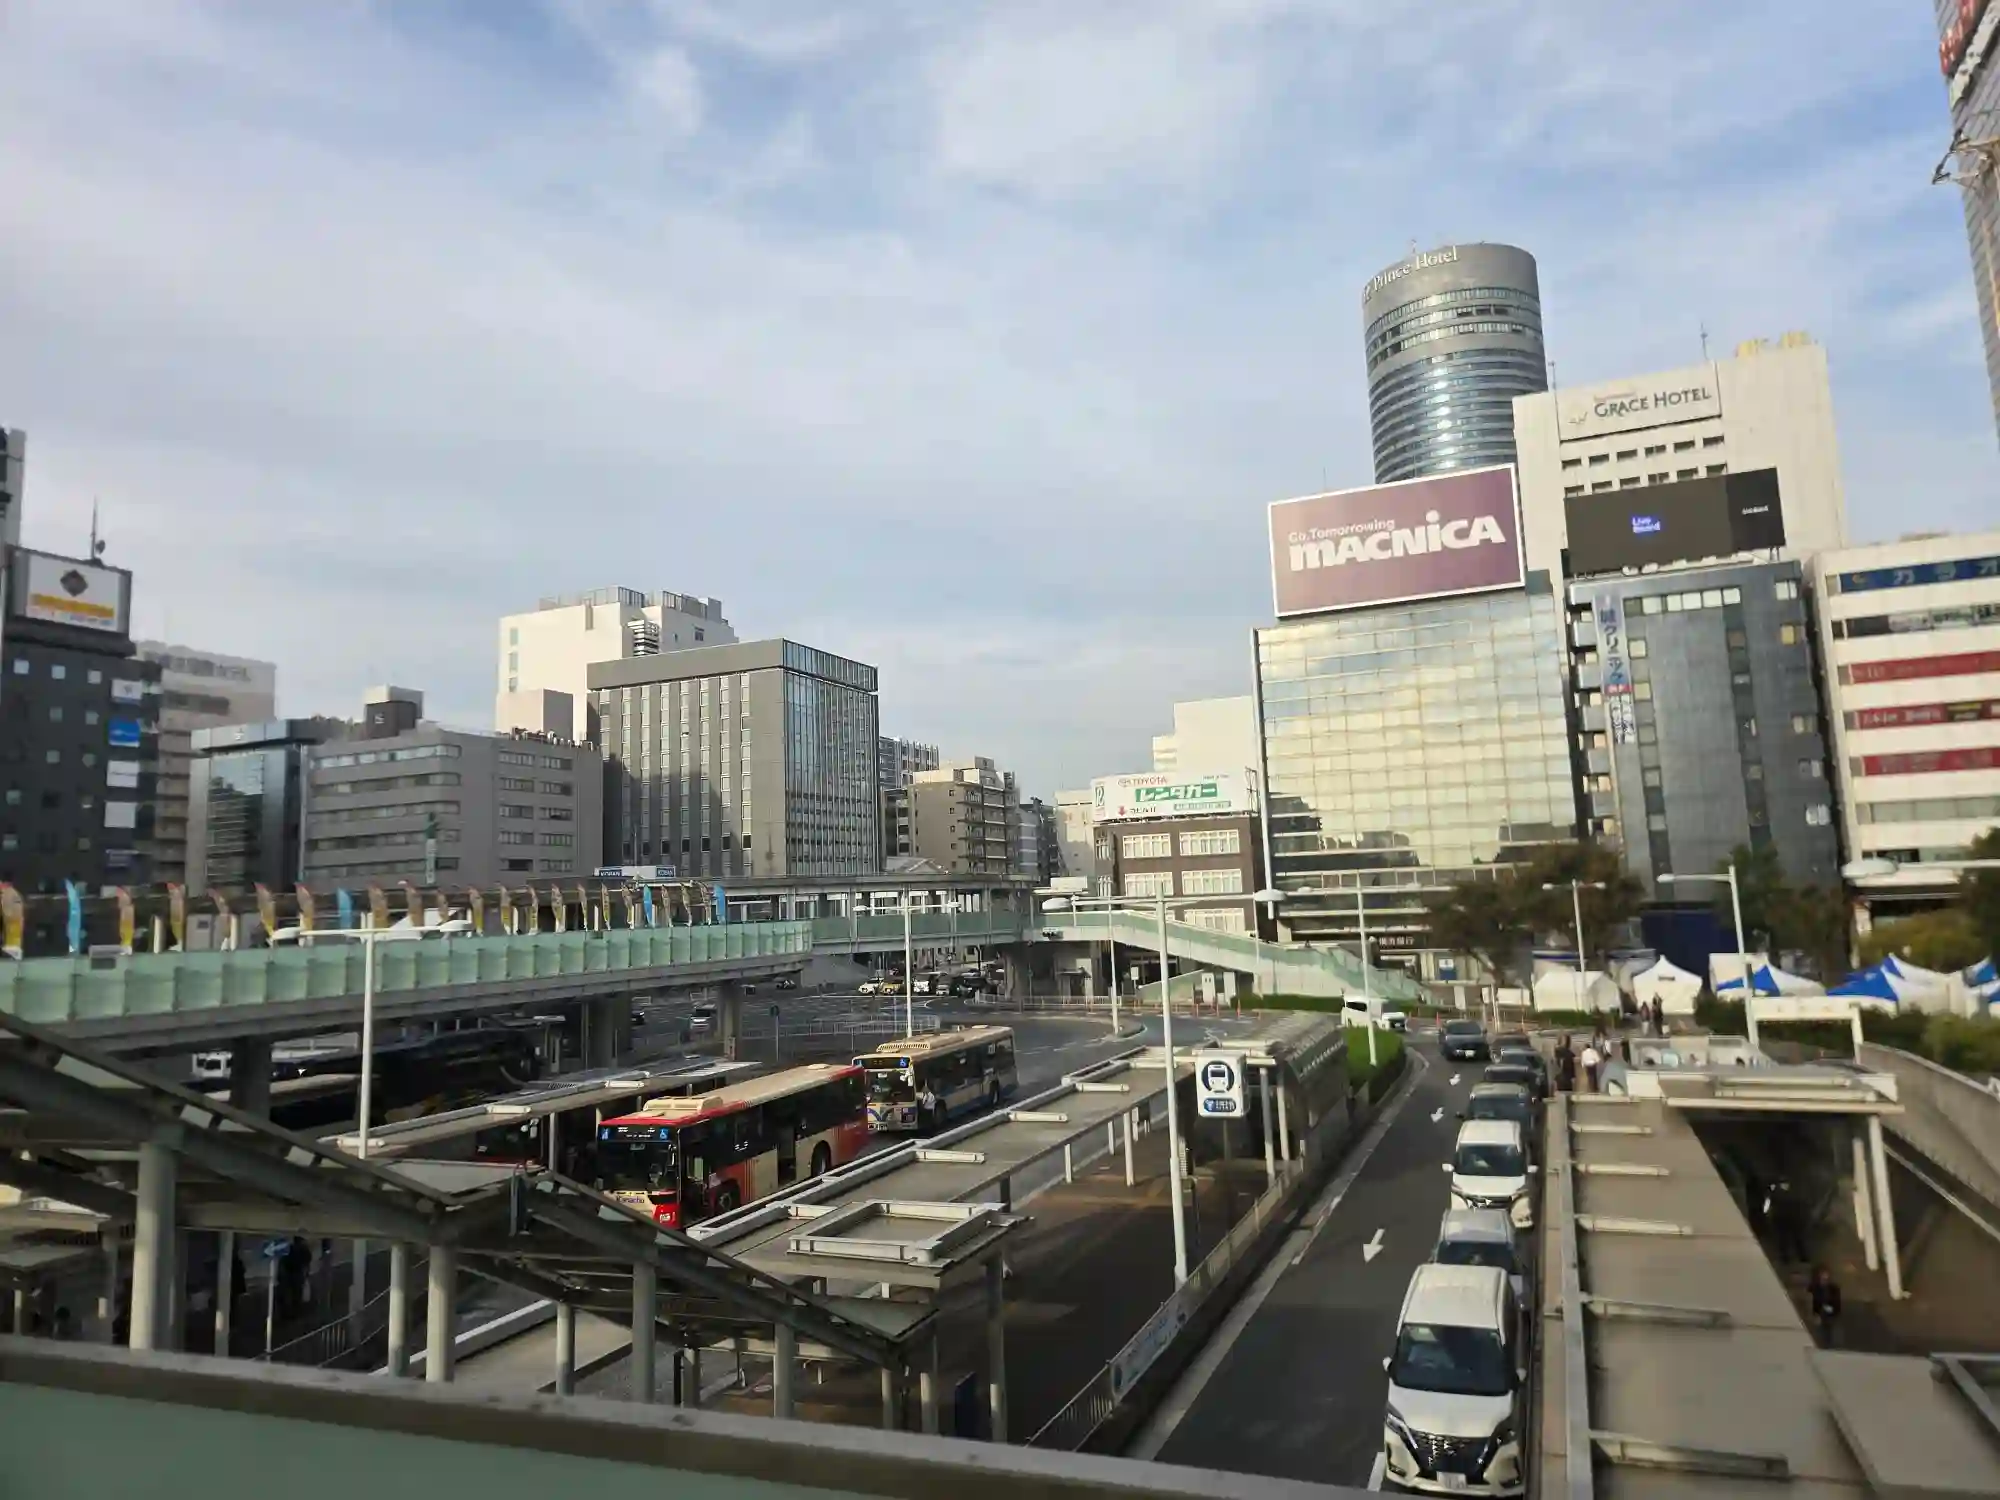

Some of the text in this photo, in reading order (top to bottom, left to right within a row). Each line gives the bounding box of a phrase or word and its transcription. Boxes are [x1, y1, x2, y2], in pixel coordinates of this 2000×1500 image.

[1374, 246, 1459, 292] Prince Hotel
[1594, 397, 1649, 418] GRACE
[1654, 387, 1712, 408] HOTEL
[1132, 775, 1168, 786] TOYOTA
[1139, 785, 1216, 802] レンタカー
